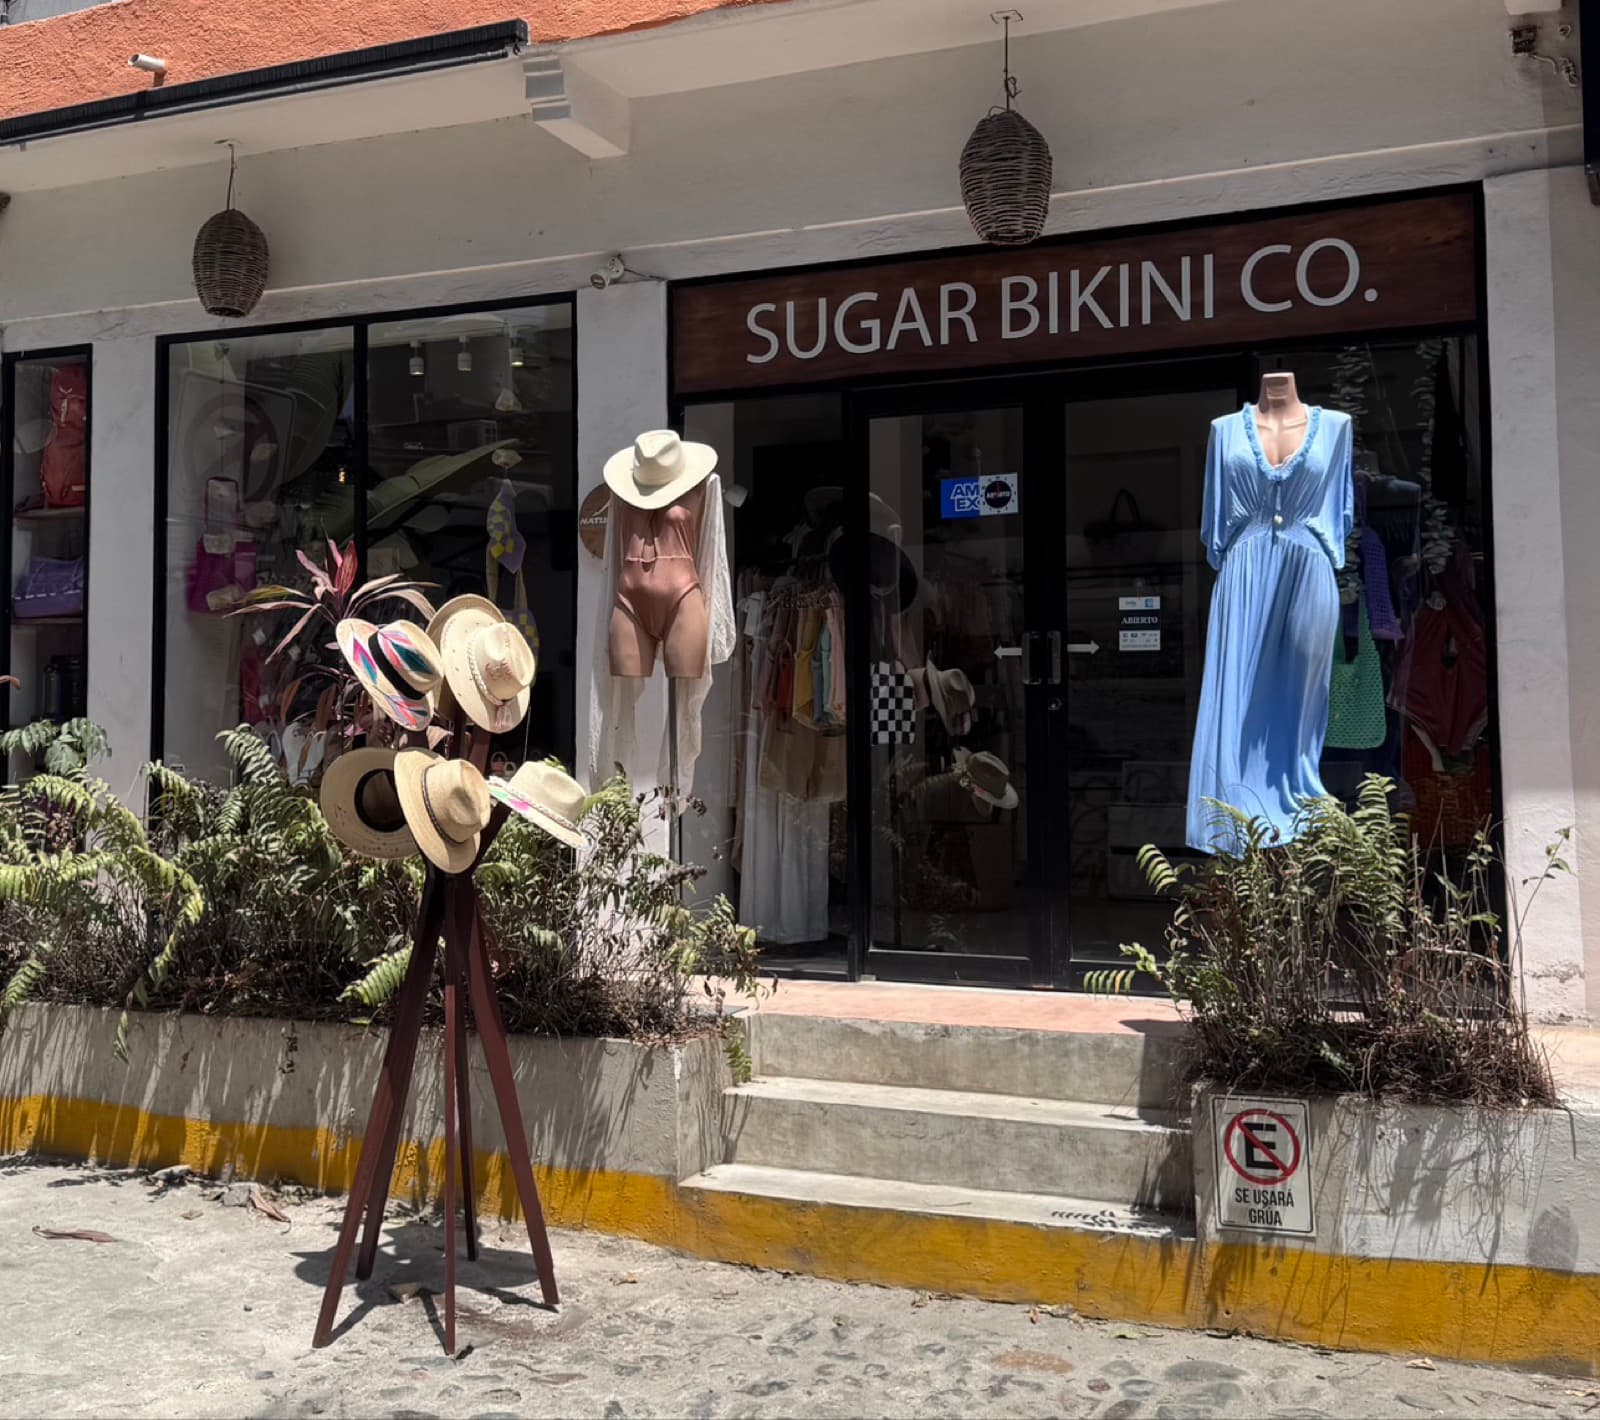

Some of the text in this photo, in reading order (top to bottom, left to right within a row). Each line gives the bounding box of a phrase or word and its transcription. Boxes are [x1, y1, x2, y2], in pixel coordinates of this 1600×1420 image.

[745, 237, 1379, 364] SUGAR BIKINI CO.
[951, 483, 980, 499] AM
[955, 497, 980, 512] EX
[1121, 616, 1158, 624] ABIERTO
[1235, 1187, 1294, 1207] SE USARÁ
[1248, 1207, 1282, 1225] GRÚA
